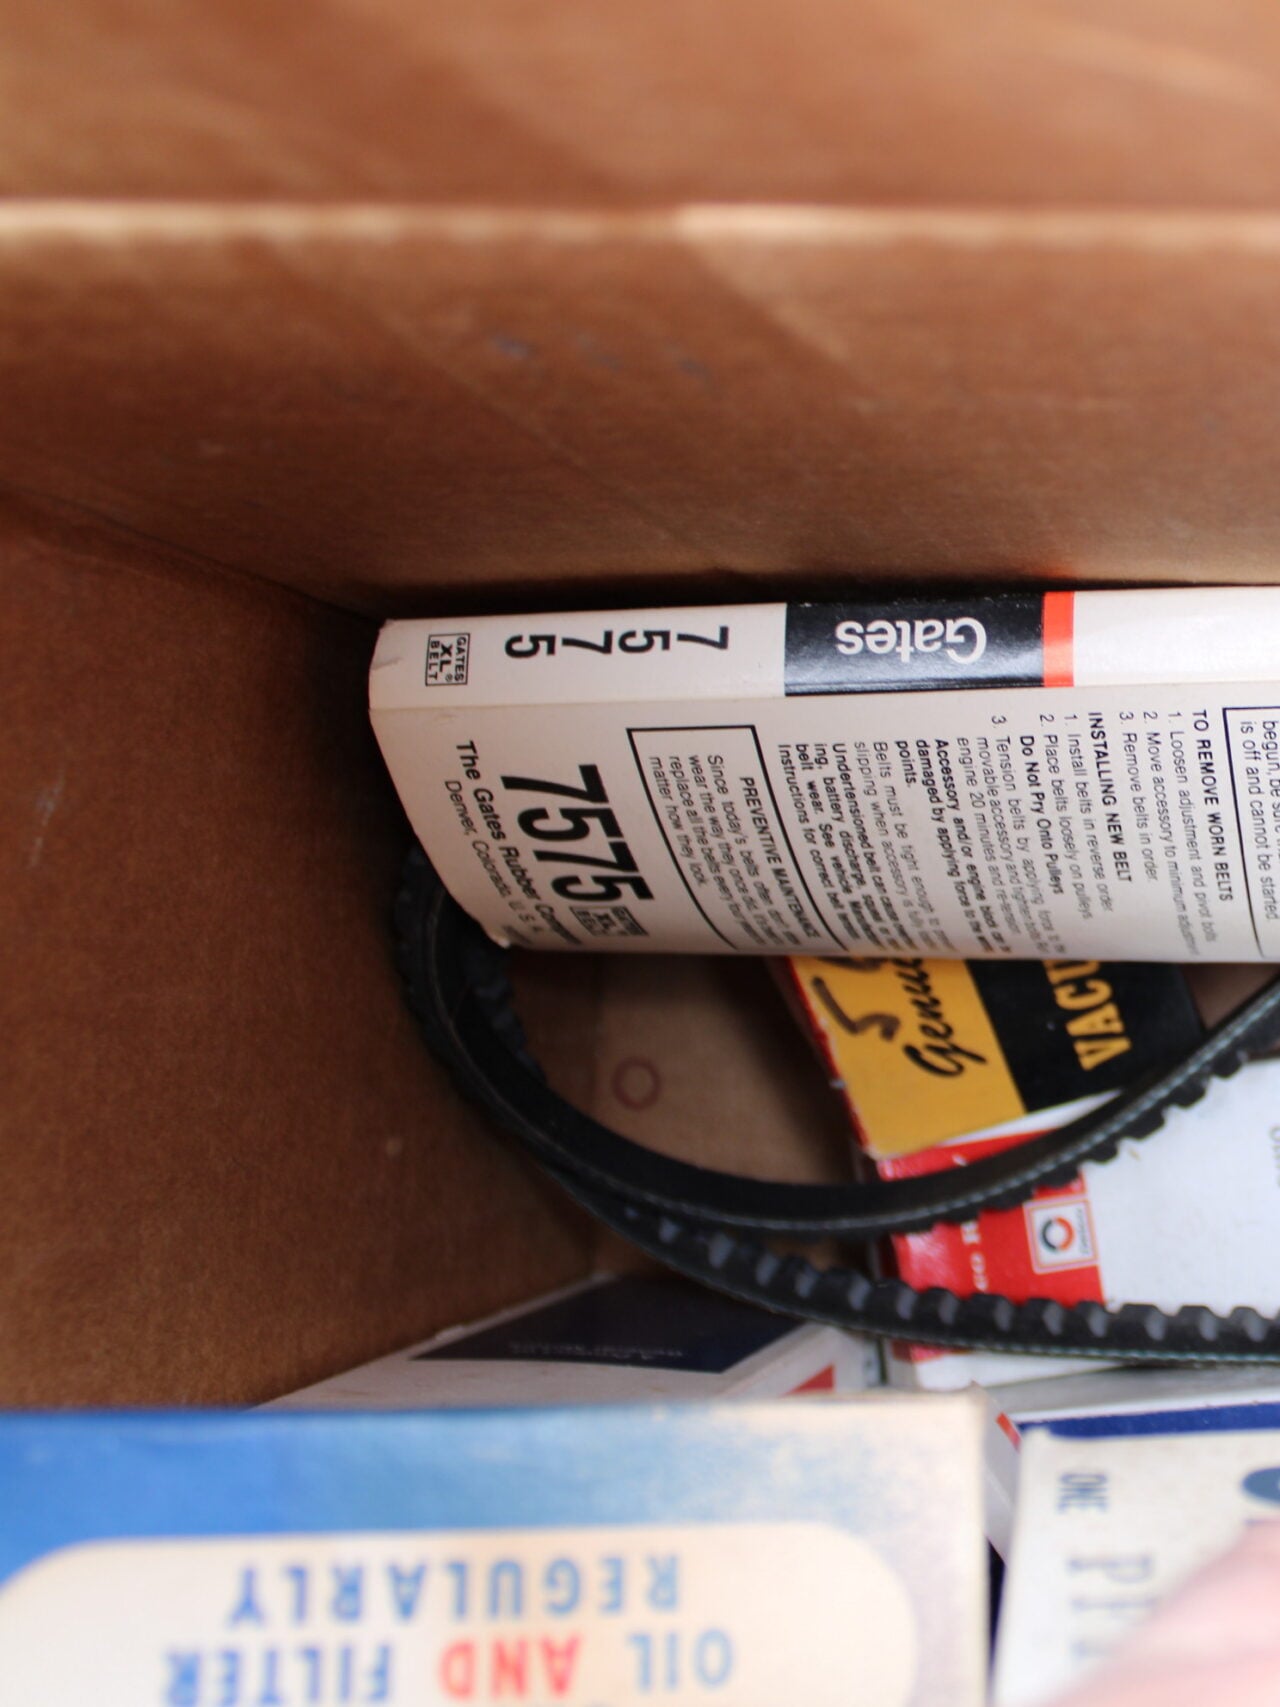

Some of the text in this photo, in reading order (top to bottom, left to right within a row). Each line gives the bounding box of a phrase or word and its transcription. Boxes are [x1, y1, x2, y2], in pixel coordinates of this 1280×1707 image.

[427, 640, 441, 682] BELT
[454, 636, 467, 682] GATES
[835, 616, 987, 665] Gates
[1020, 736, 1035, 756] Do
[1240, 721, 1257, 734] is
[1261, 721, 1280, 775] begun,
[874, 742, 892, 778] Belts
[896, 741, 914, 788] points.
[916, 740, 945, 804] damaged
[995, 736, 1016, 791] Tension
[1043, 734, 1061, 774] Place
[1067, 734, 1087, 776] Install
[1122, 733, 1144, 792] Remove
[1146, 732, 1163, 772] Move
[1170, 731, 1189, 783] Loosen
[1242, 740, 1260, 761] off
[668, 756, 694, 807] replace
[778, 744, 812, 824] Instructions
[796, 744, 814, 770] belt
[819, 823, 835, 848] See
[1026, 762, 1041, 787] Not
[1051, 779, 1067, 812] belts
[1088, 712, 1132, 882] INSTALLING NEW BELT
[1246, 767, 1264, 795] and
[444, 780, 477, 835] Denver,
[456, 740, 482, 780] The
[473, 788, 506, 840] Gates
[498, 846, 541, 901] Rubber
[649, 756, 674, 801] matter
[665, 805, 683, 831] how
[677, 834, 695, 859] they
[686, 810, 702, 824] all
[707, 755, 727, 795] Since
[720, 801, 748, 845] today's
[739, 850, 760, 877] belts
[823, 777, 844, 823] battery
[833, 743, 869, 850] Undertensioned
[864, 852, 881, 872] belt
[855, 741, 877, 797] slipping
[870, 802, 888, 836] when
[887, 841, 908, 896] accessory
[885, 786, 902, 817] must
[931, 807, 948, 823] by
[935, 740, 960, 811] Accessory
[953, 817, 973, 858] and/or
[966, 864, 986, 900] engine
[957, 738, 1004, 887] engine 20 minutes and
[977, 737, 1000, 797] movable
[990, 800, 1014, 861] accessory
[1006, 863, 1021, 885] and
[1008, 799, 1024, 830] belts
[1030, 792, 1046, 814] Pry
[1075, 782, 1092, 814] belts
[1133, 797, 1150, 829] belts
[1152, 777, 1174, 842] accessory
[1192, 709, 1233, 901] TO REMOVE WORN BELTS
[500, 765, 655, 902] 7575
[688, 755, 749, 893] wear the way they once
[693, 826, 710, 845] the
[803, 828, 818, 844] for
[894, 823, 907, 839] be
[1014, 837, 1028, 851] by
[1037, 819, 1053, 850] Onto
[1058, 816, 1077, 861] loosely
[1083, 819, 1094, 831] in
[1139, 833, 1152, 844] in
[1179, 790, 1200, 861] adjustment
[1250, 801, 1270, 849] cannot
[702, 847, 721, 874] belts
[739, 777, 781, 864] PREVENTIVE
[772, 868, 821, 938] MAINTENANCE
[810, 849, 832, 889] correct
[900, 844, 918, 871] tight
[937, 827, 962, 878] applying
[1070, 864, 1083, 879] on
[1085, 835, 1103, 880] reverse
[1164, 846, 1177, 858] to
[1257, 854, 1273, 870] be
[1021, 859, 1043, 905] applying
[1165, 861, 1186, 912] minimum
[1191, 866, 1206, 888] and
[228, 1553, 680, 1628] REGULARLY
[165, 1628, 734, 1706] OIL AND FILTER
